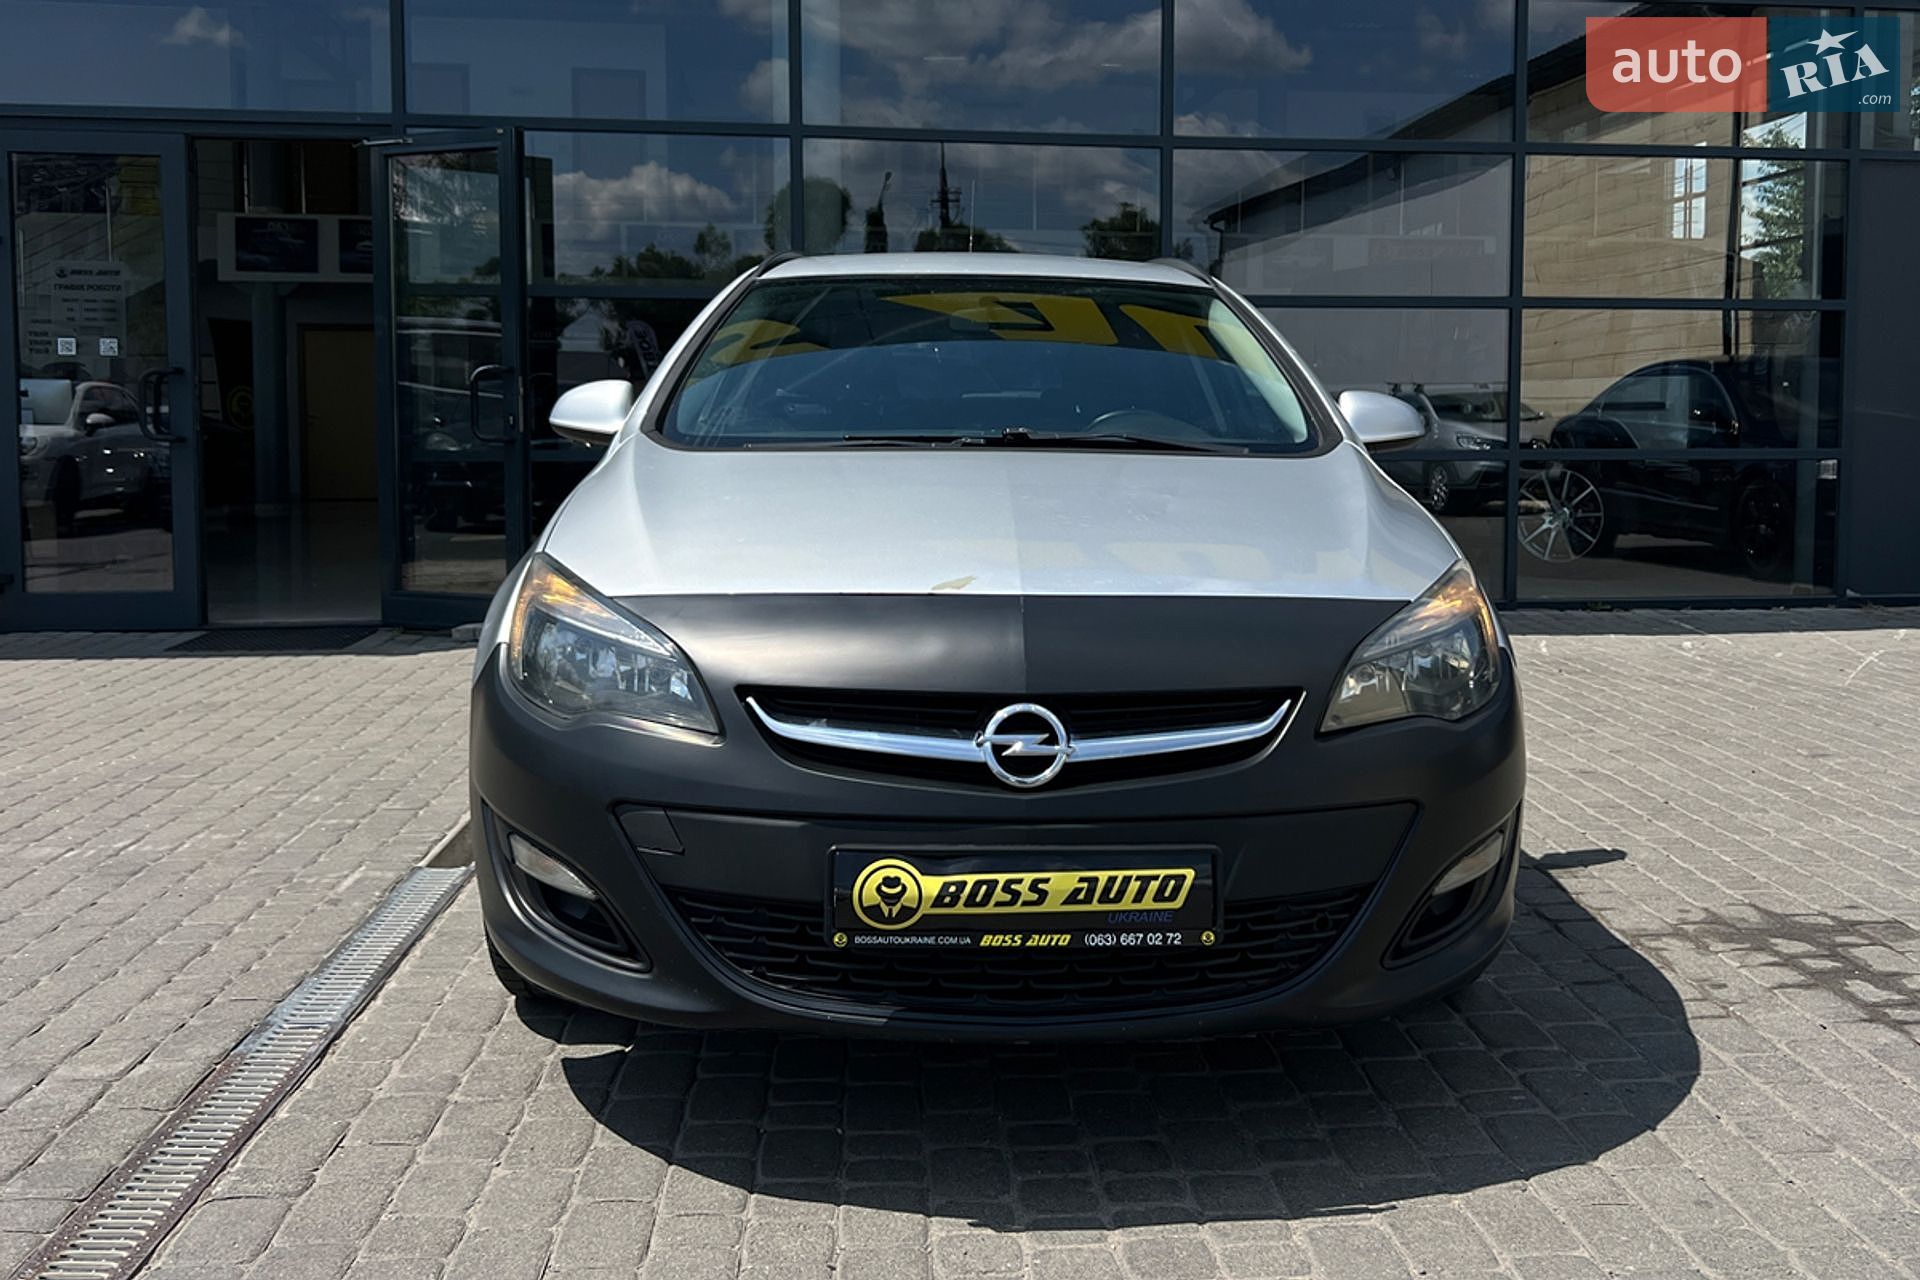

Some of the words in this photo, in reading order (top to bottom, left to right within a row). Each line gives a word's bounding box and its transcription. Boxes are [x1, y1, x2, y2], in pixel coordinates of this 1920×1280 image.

[930, 877, 1052, 909] BOSS
[1060, 873, 1188, 906] AUTO
[1107, 910, 1174, 924] UKRAINE
[979, 934, 1023, 946] BOSS
[1025, 934, 1071, 946] AUTO
[1084, 933, 1117, 946] (063)
[1120, 933, 1143, 945] 667
[1147, 933, 1162, 945] 02
[1165, 933, 1182, 945] 72
